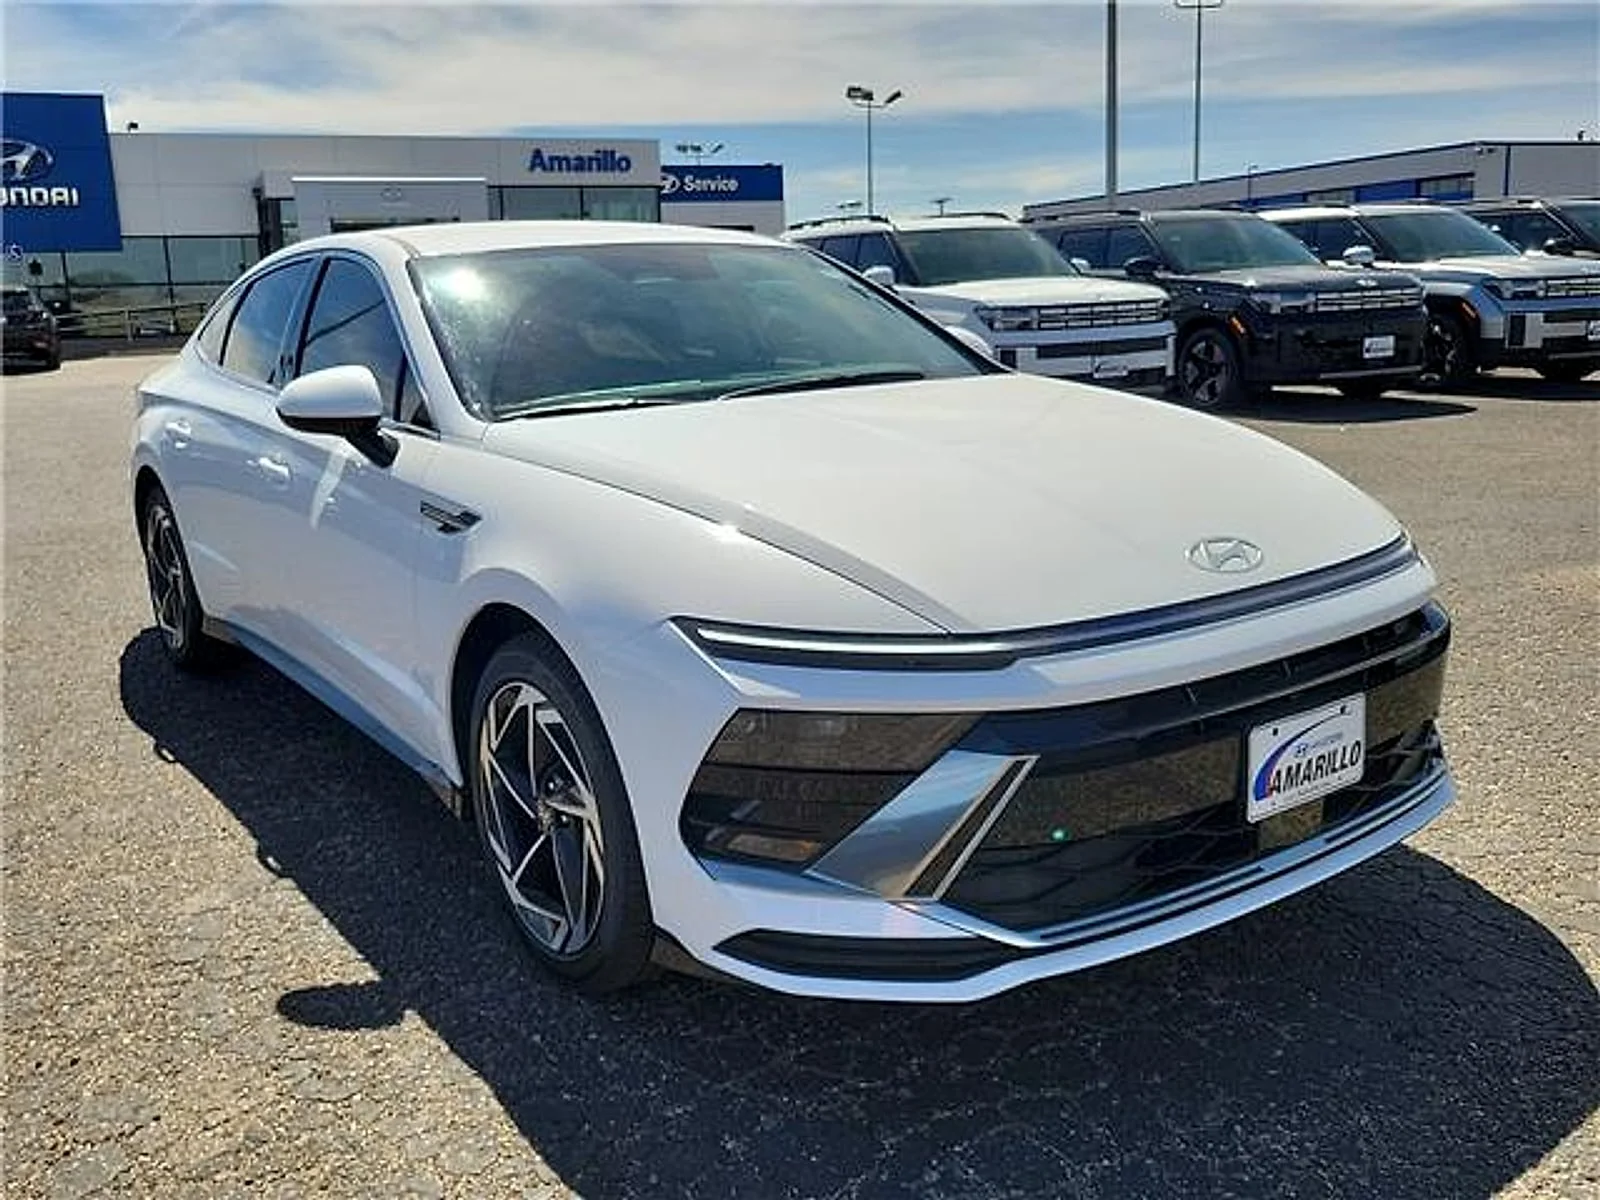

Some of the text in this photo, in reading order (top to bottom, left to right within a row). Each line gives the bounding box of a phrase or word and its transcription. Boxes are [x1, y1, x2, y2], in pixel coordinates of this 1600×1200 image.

[529, 148, 632, 173] Amarillo
[683, 175, 738, 193] Service
[1267, 740, 1361, 795] AMARILLO
